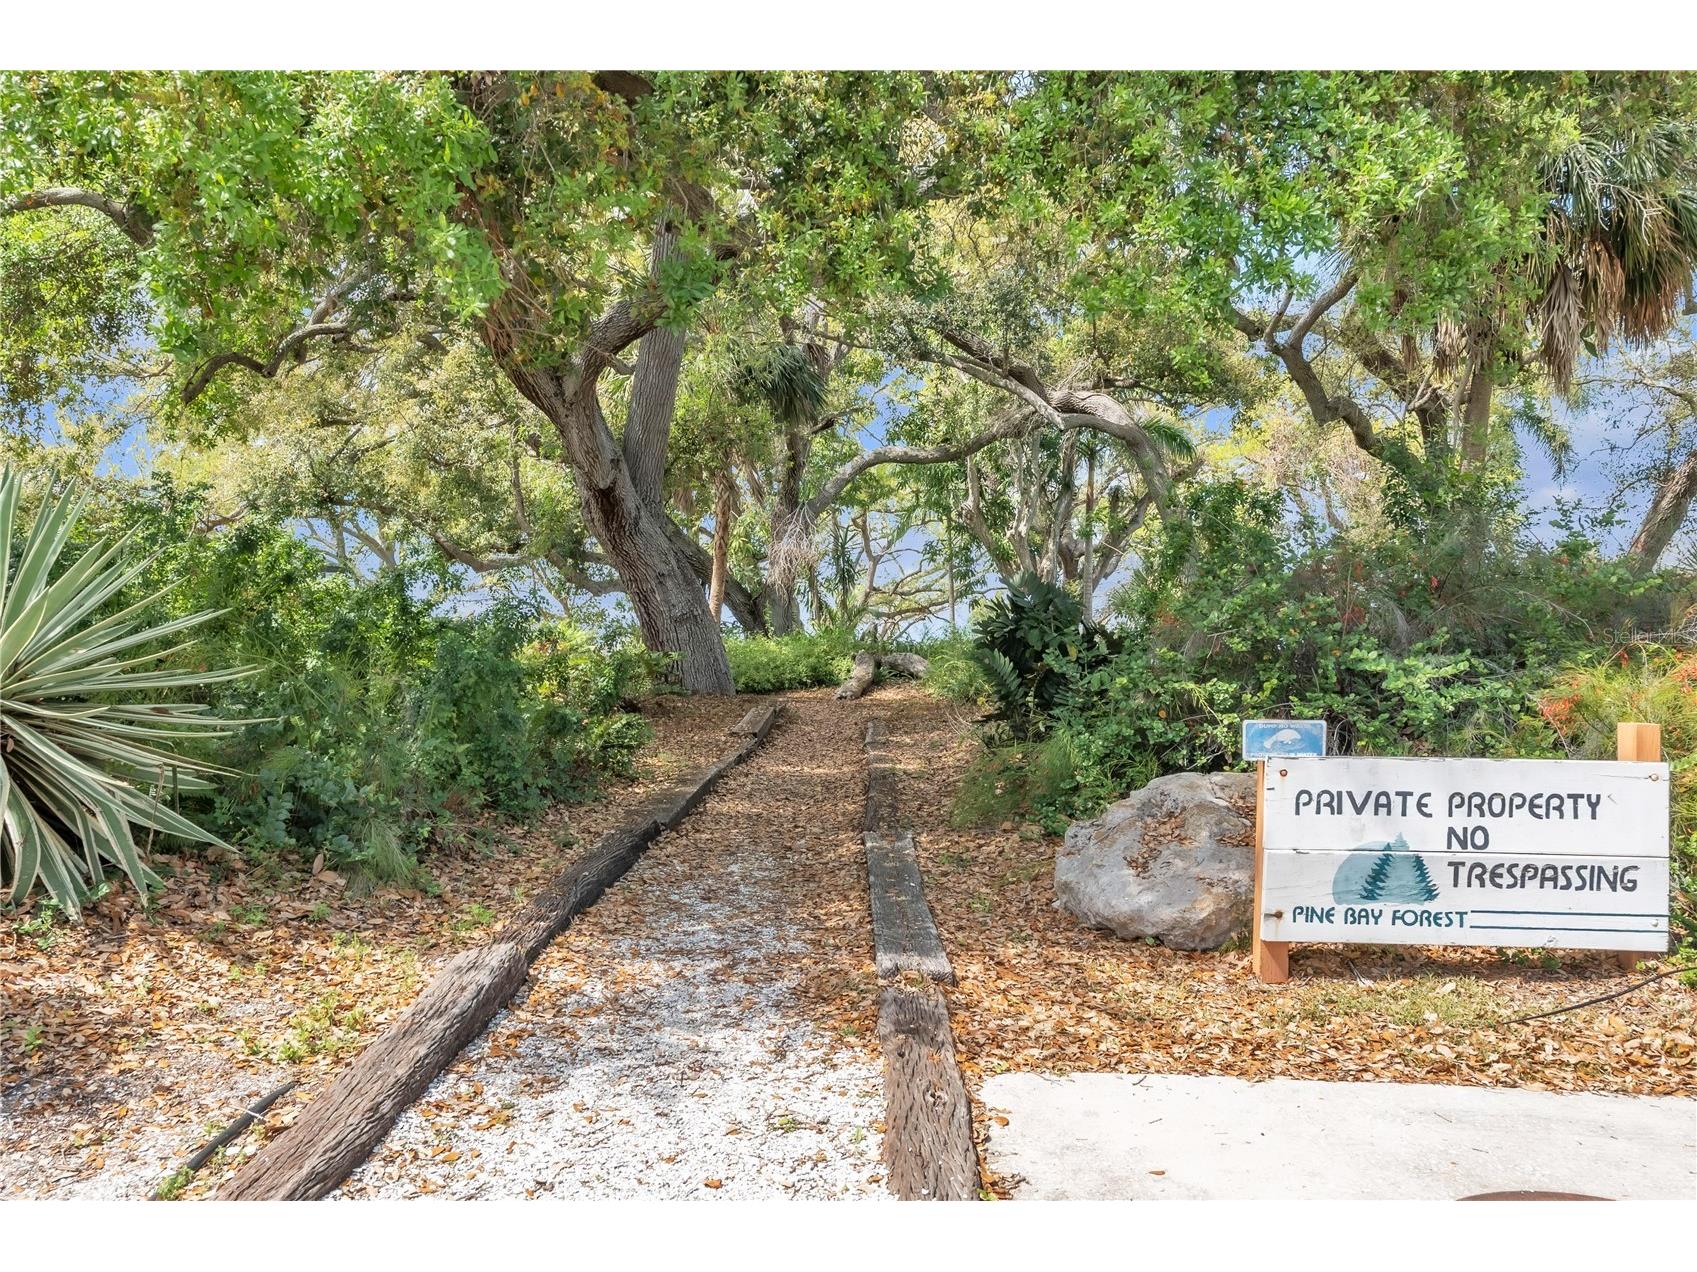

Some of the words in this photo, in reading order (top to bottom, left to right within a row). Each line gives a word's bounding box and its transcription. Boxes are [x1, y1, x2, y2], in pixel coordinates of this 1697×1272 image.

[1295, 789, 1433, 818] PRIVATE
[1448, 791, 1601, 820] PROPERTY
[1447, 825, 1490, 850] NO
[1448, 861, 1640, 892] TRESPASSING
[1292, 906, 1335, 924] PINE
[1344, 908, 1383, 926] BAY
[1391, 909, 1468, 929] FOREST
